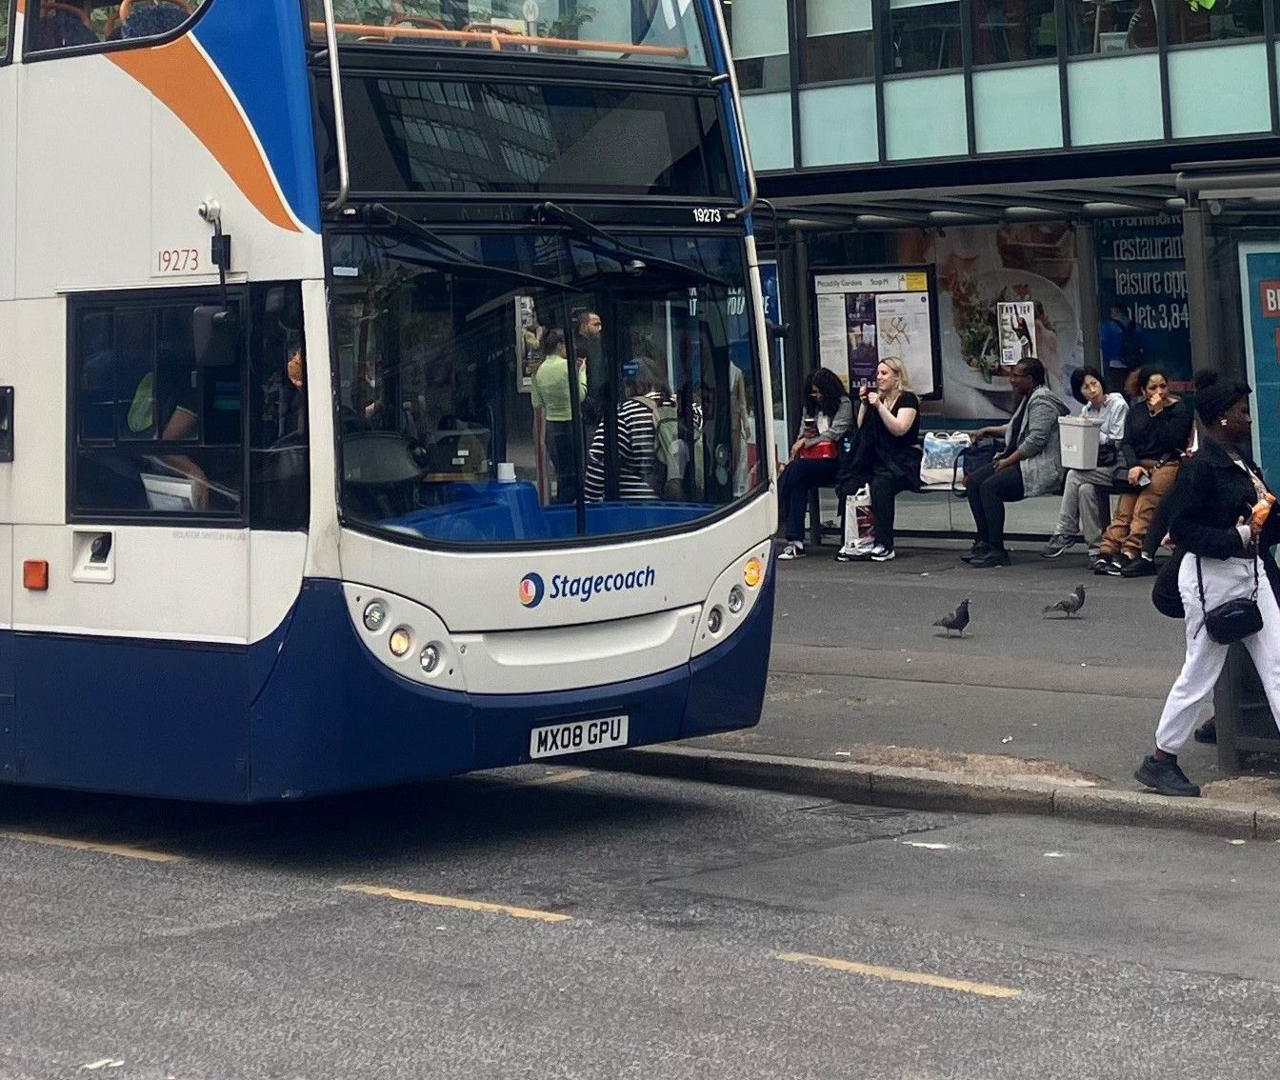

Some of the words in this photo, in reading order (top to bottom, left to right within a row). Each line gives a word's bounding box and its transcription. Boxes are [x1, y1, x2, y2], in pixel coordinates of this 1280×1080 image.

[692, 208, 722, 223] 19273
[158, 249, 199, 272] 19273
[1112, 236, 1184, 261] restauran
[1114, 268, 1161, 295] leisure
[549, 565, 656, 602] Stagecoach
[537, 725, 584, 753] MX08
[587, 718, 622, 745] GPU
